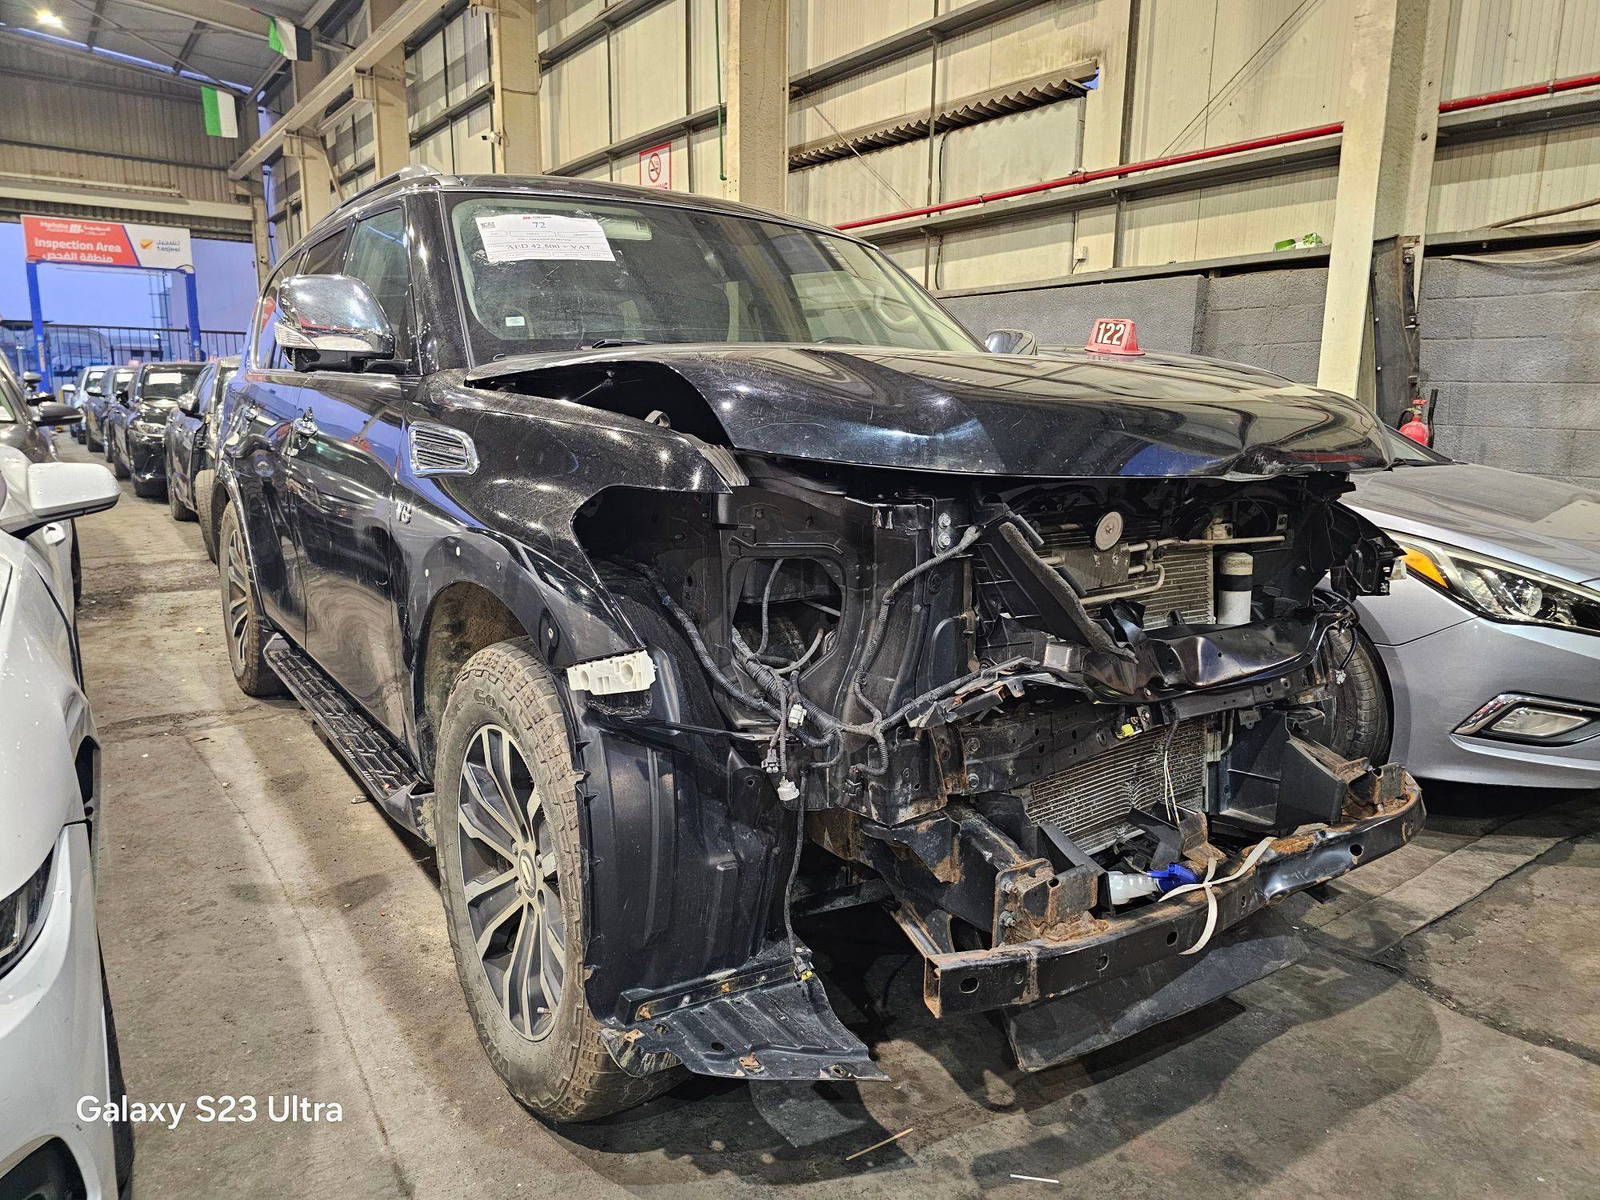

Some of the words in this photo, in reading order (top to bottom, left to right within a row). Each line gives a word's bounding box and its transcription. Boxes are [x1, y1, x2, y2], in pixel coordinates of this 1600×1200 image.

[532, 221, 547, 229] 72
[35, 238, 93, 250] Inspection
[96, 242, 122, 253] Area
[1097, 322, 1125, 345] 122
